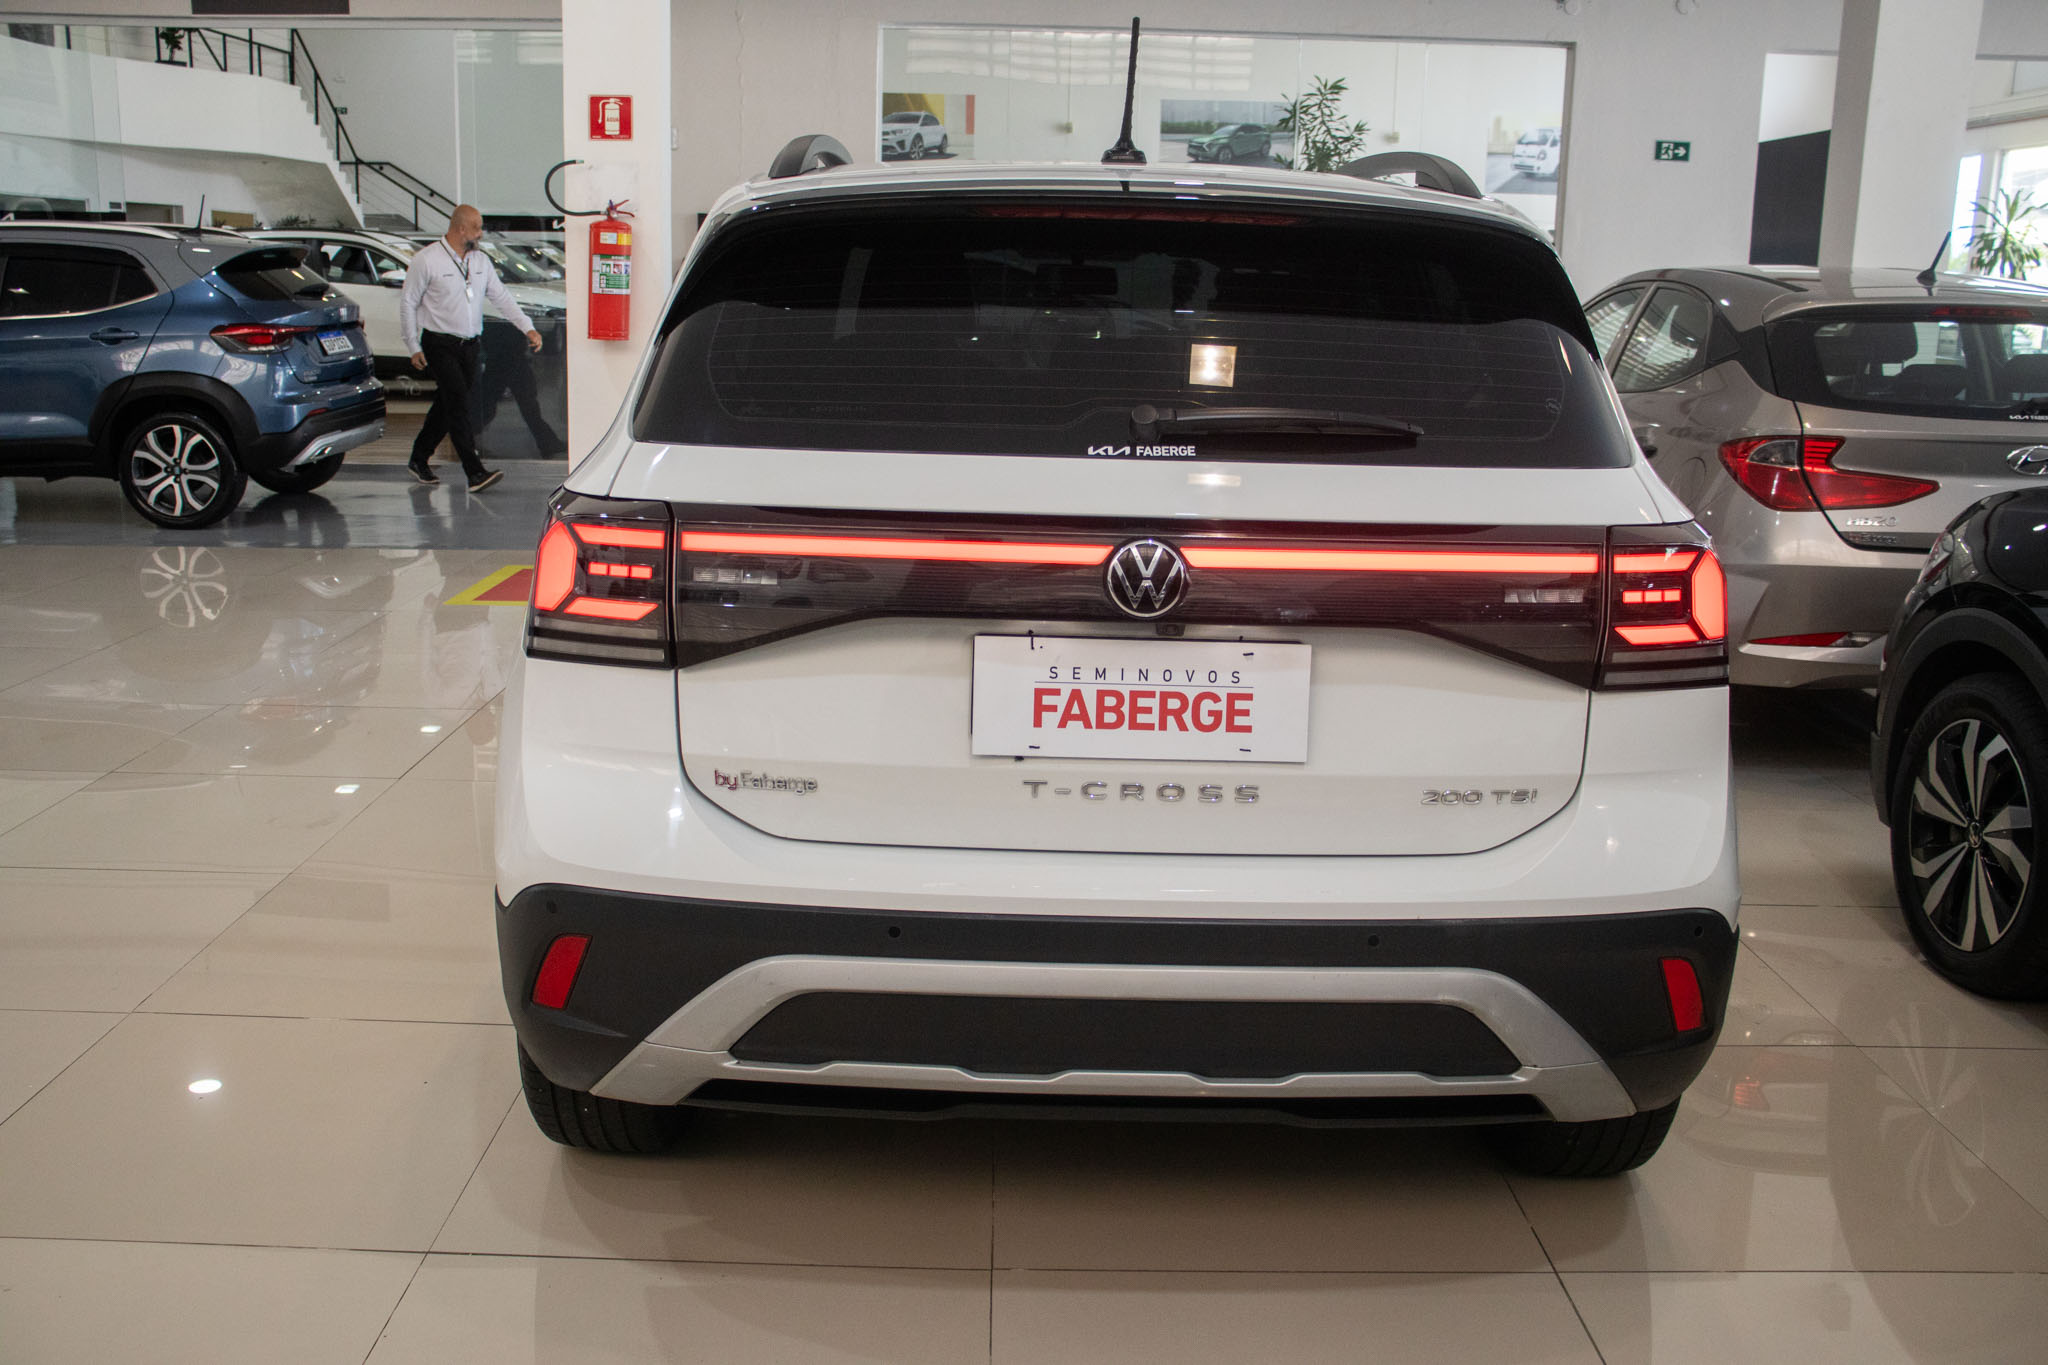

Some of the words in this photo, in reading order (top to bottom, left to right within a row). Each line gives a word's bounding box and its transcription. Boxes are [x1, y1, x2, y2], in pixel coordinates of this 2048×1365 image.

[1087, 445, 1131, 456] KIA
[1136, 445, 1196, 457] FABERGE
[1049, 666, 1241, 684] SEMINOVOS
[1032, 687, 1254, 733] FABERGE
[714, 769, 737, 791] by
[1022, 779, 1260, 803] T-CROSS
[1421, 789, 1483, 805] 200
